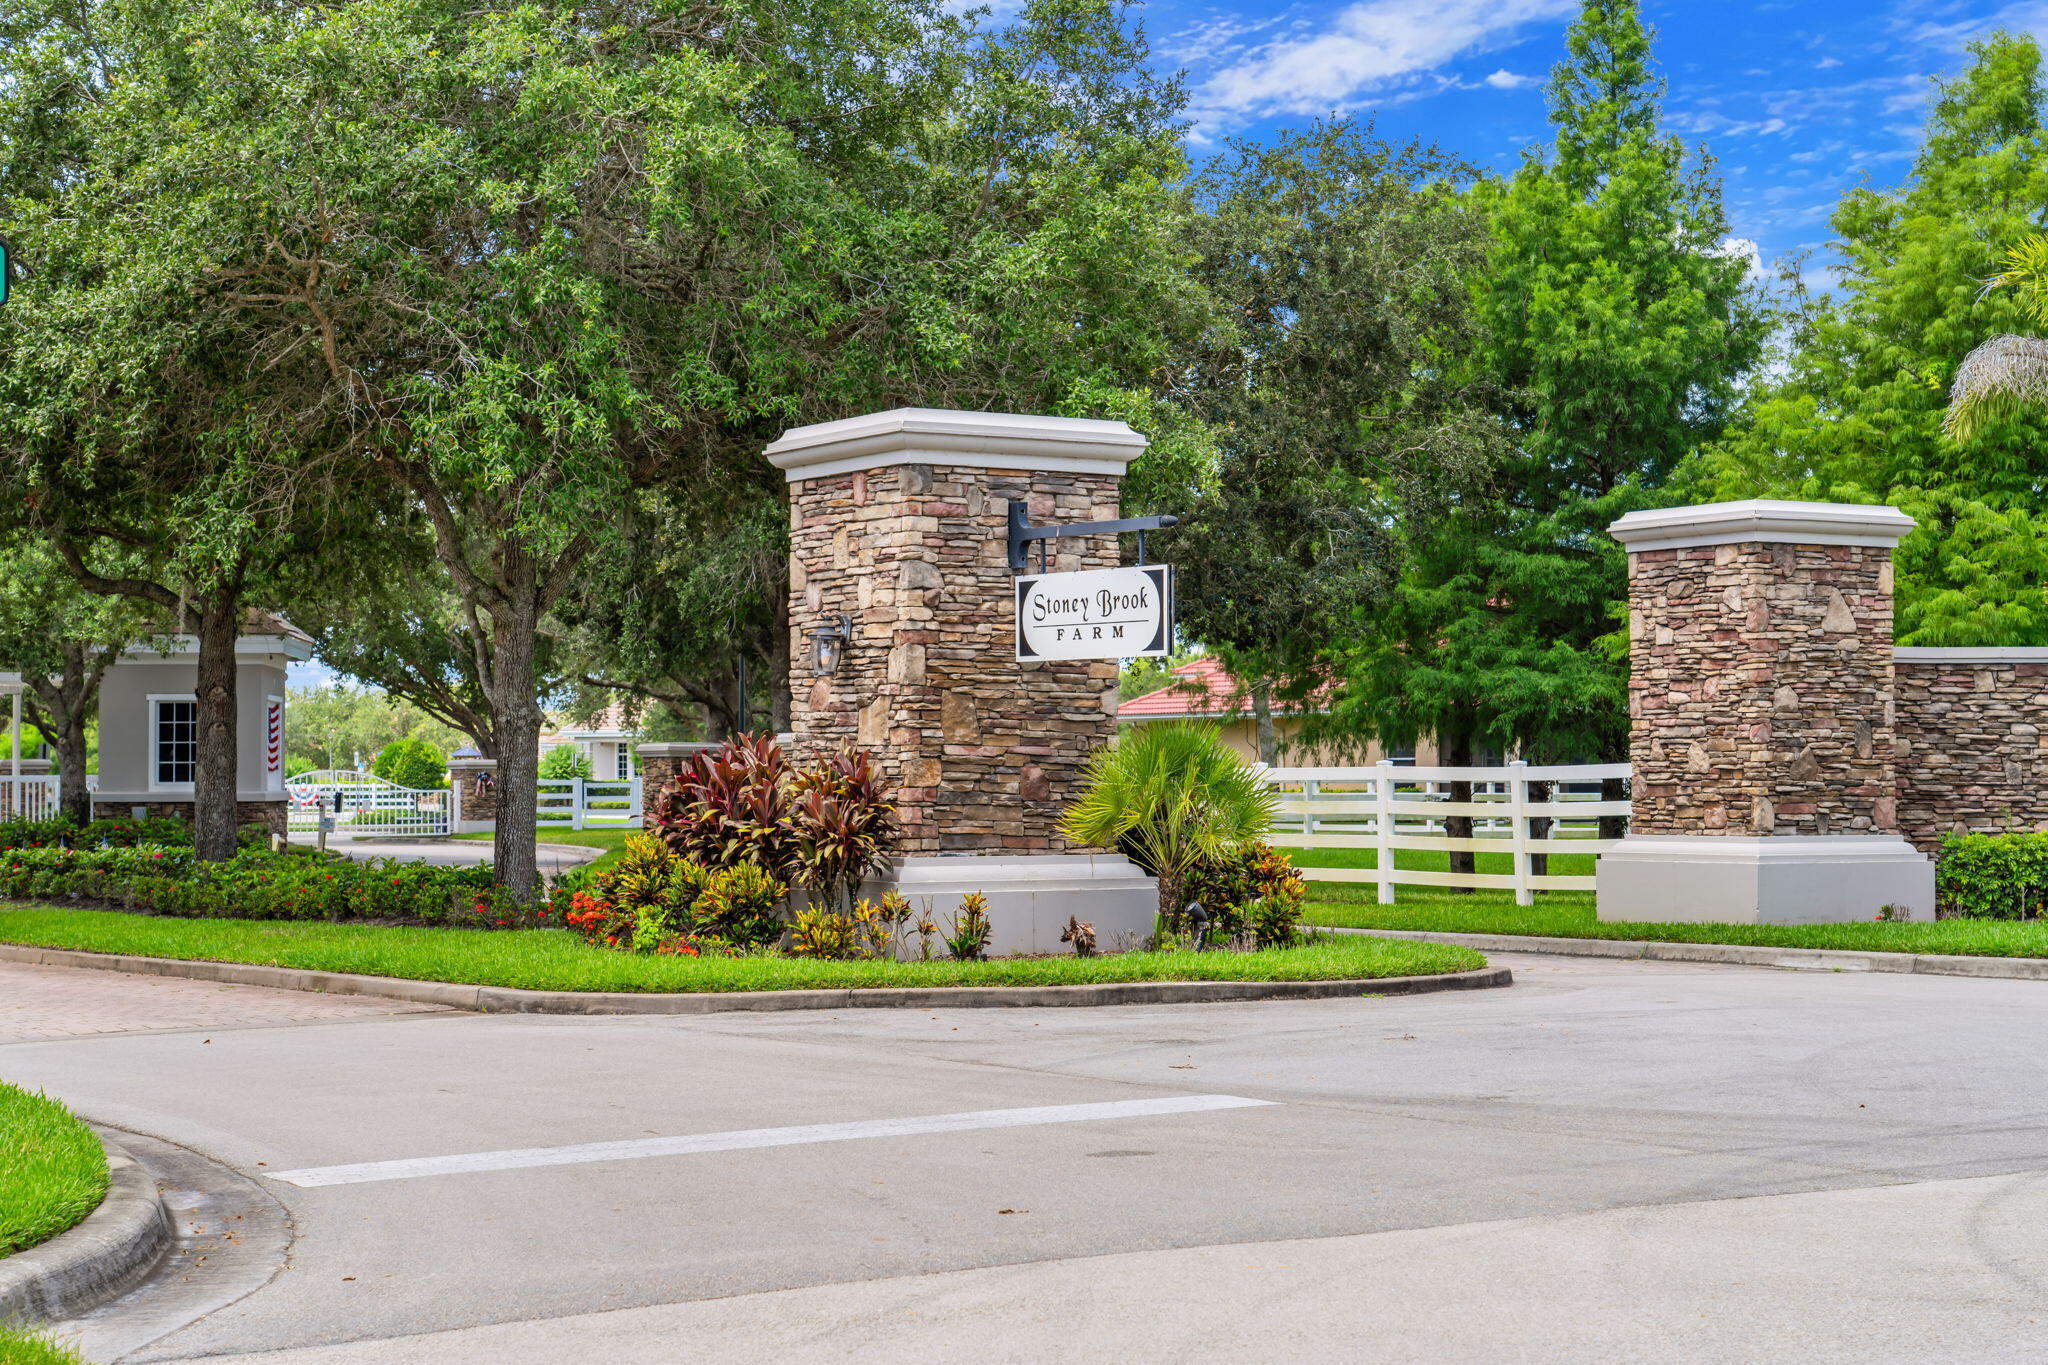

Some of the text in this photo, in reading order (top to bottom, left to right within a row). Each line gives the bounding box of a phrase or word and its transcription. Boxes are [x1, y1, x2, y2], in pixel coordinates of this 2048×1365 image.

[1033, 587, 1149, 621] Stoney Brook
[1057, 626, 1124, 641] FARM
